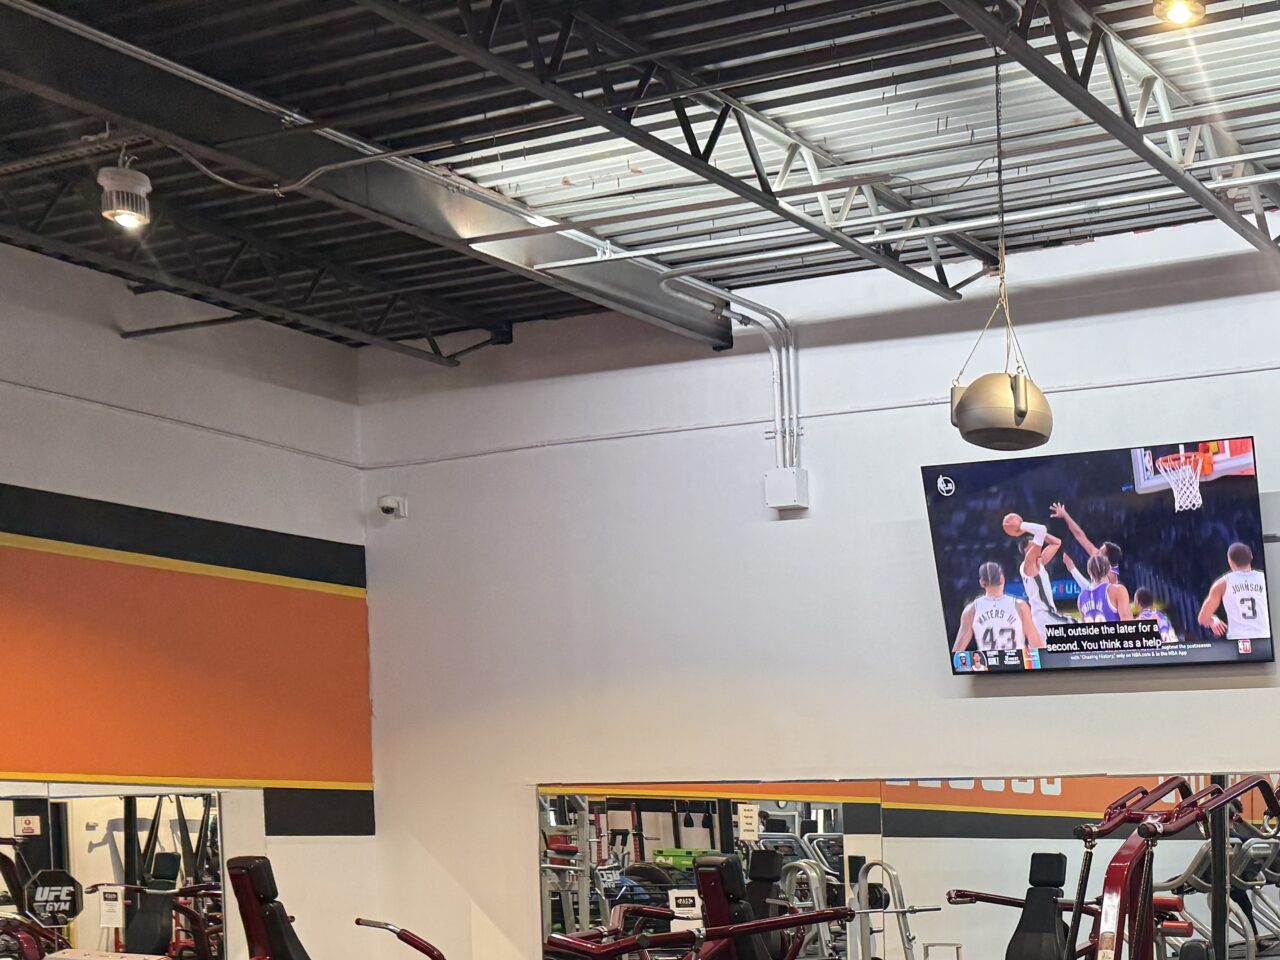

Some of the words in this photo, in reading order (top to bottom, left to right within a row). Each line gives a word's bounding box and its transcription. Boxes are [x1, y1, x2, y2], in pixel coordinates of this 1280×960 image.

[1232, 583, 1263, 594] JOHNSON
[1240, 597, 1257, 620] 3
[1046, 627, 1066, 637] Well,
[1068, 626, 1099, 636] outside
[1101, 625, 1115, 635] the
[1117, 624, 1136, 634] later
[1138, 623, 1151, 632] for
[982, 627, 1017, 650] 43
[1047, 641, 1080, 652] second.
[1081, 640, 1098, 650] You
[1100, 639, 1120, 649] think
[1123, 640, 1133, 648] as
[1143, 637, 1161, 648] help
[34, 886, 75, 901] UFC
[45, 902, 70, 911] GYM
